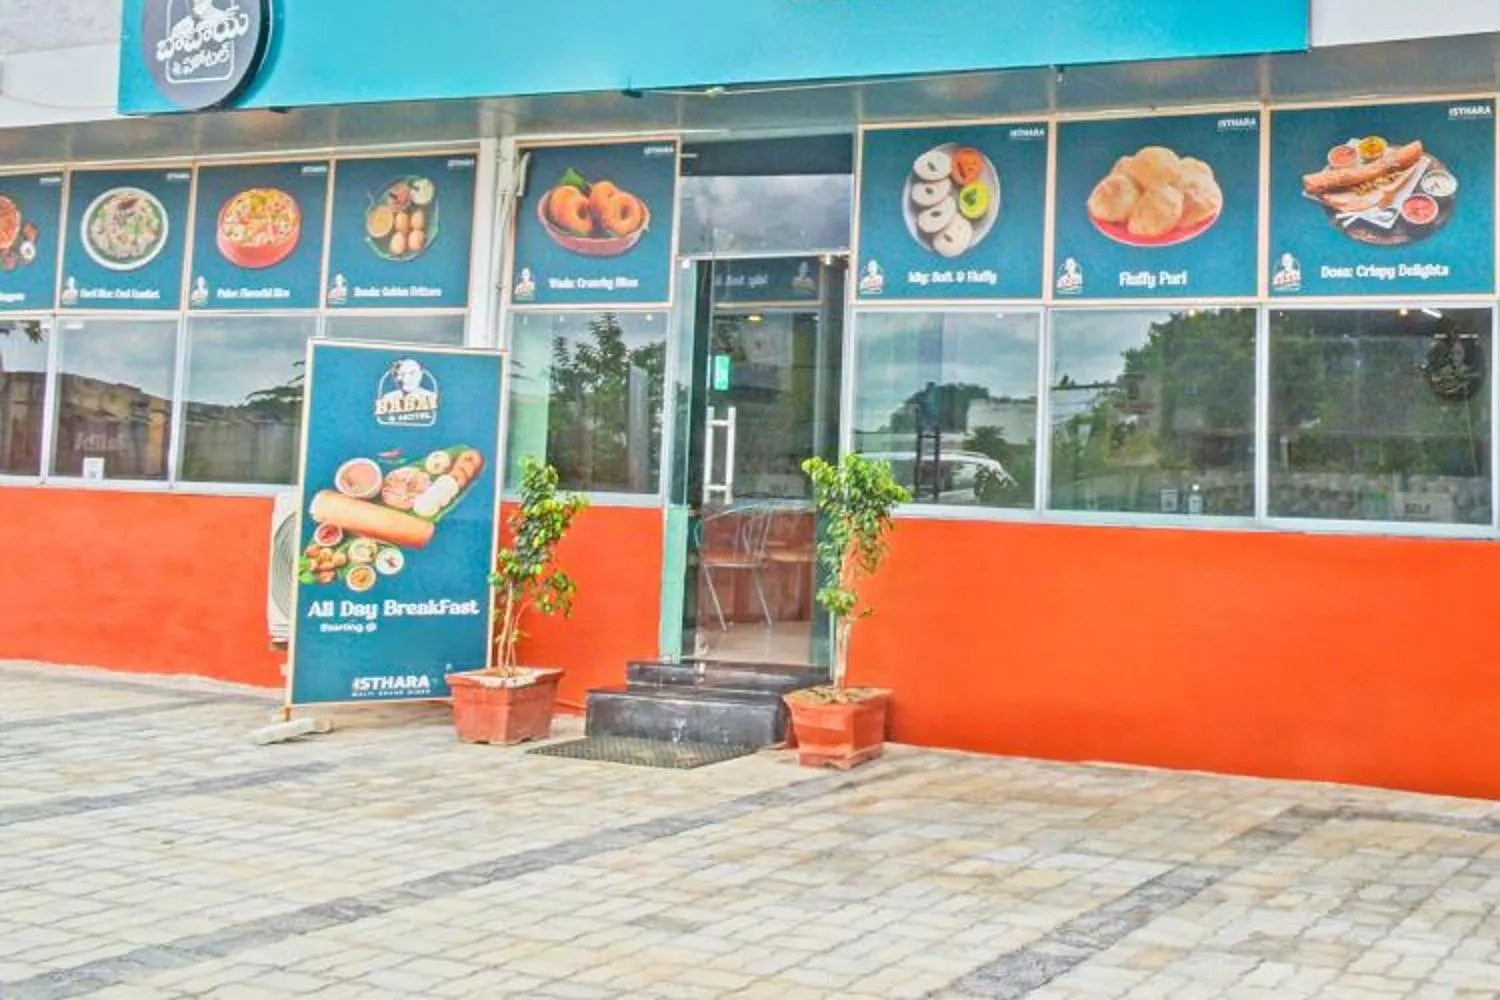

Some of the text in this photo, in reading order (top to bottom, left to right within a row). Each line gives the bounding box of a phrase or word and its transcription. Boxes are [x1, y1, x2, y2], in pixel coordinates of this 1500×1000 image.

[1448, 105, 1492, 117] ISTHARA
[1217, 117, 1257, 128] ISTHARA
[967, 268, 998, 286] Fluffy
[1119, 269, 1188, 289] Fluffy Puri
[1356, 264, 1395, 280] Crispy
[1398, 263, 1450, 280] Delights
[307, 600, 334, 618] All
[340, 600, 379, 621] Day
[319, 621, 364, 634] Starting
[351, 675, 431, 691] ISTHARA
